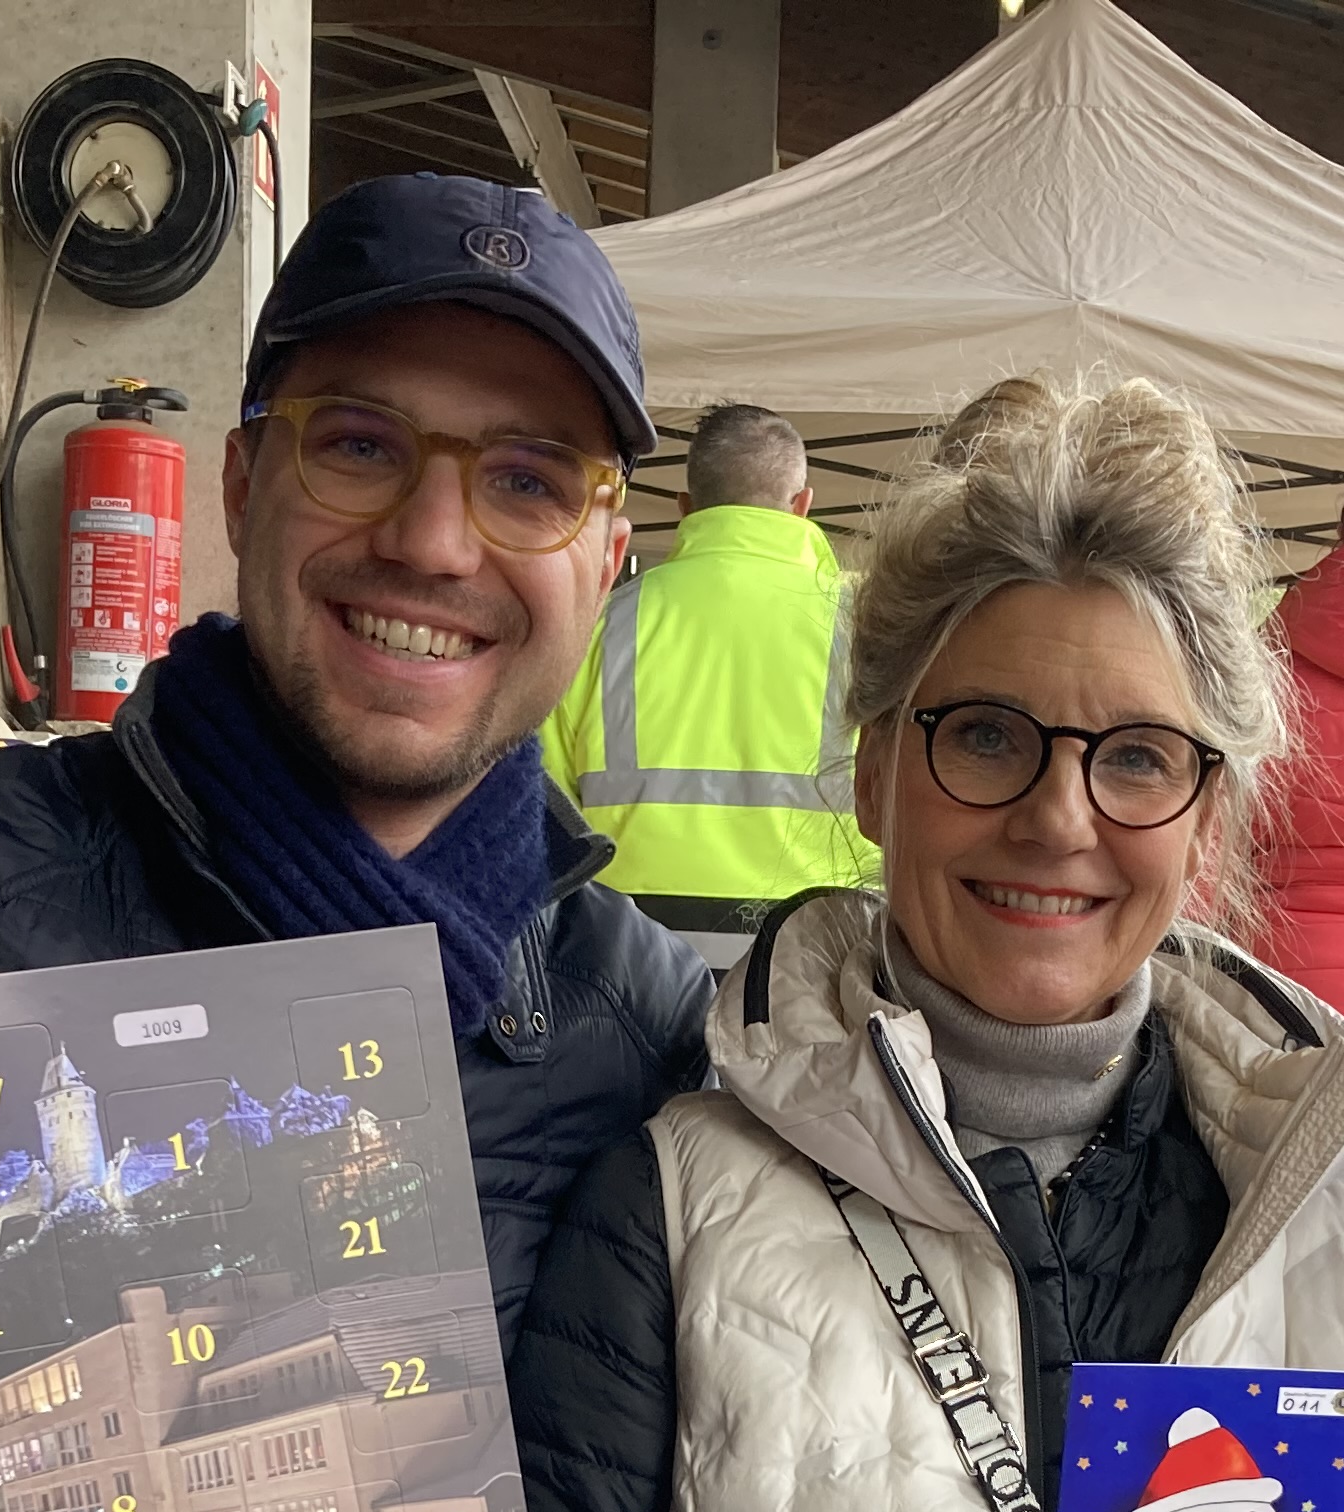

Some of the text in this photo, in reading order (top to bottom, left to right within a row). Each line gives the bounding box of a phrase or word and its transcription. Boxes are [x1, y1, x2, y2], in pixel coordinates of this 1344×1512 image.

[91, 498, 130, 509] GLORIA
[140, 1018, 184, 1040] 1009
[338, 1040, 384, 1082] 13
[170, 1133, 190, 1171] 1
[340, 1217, 387, 1259] 21
[168, 1323, 215, 1366] 10
[381, 1356, 430, 1400] 22
[1283, 1398, 1319, 1413] 011
